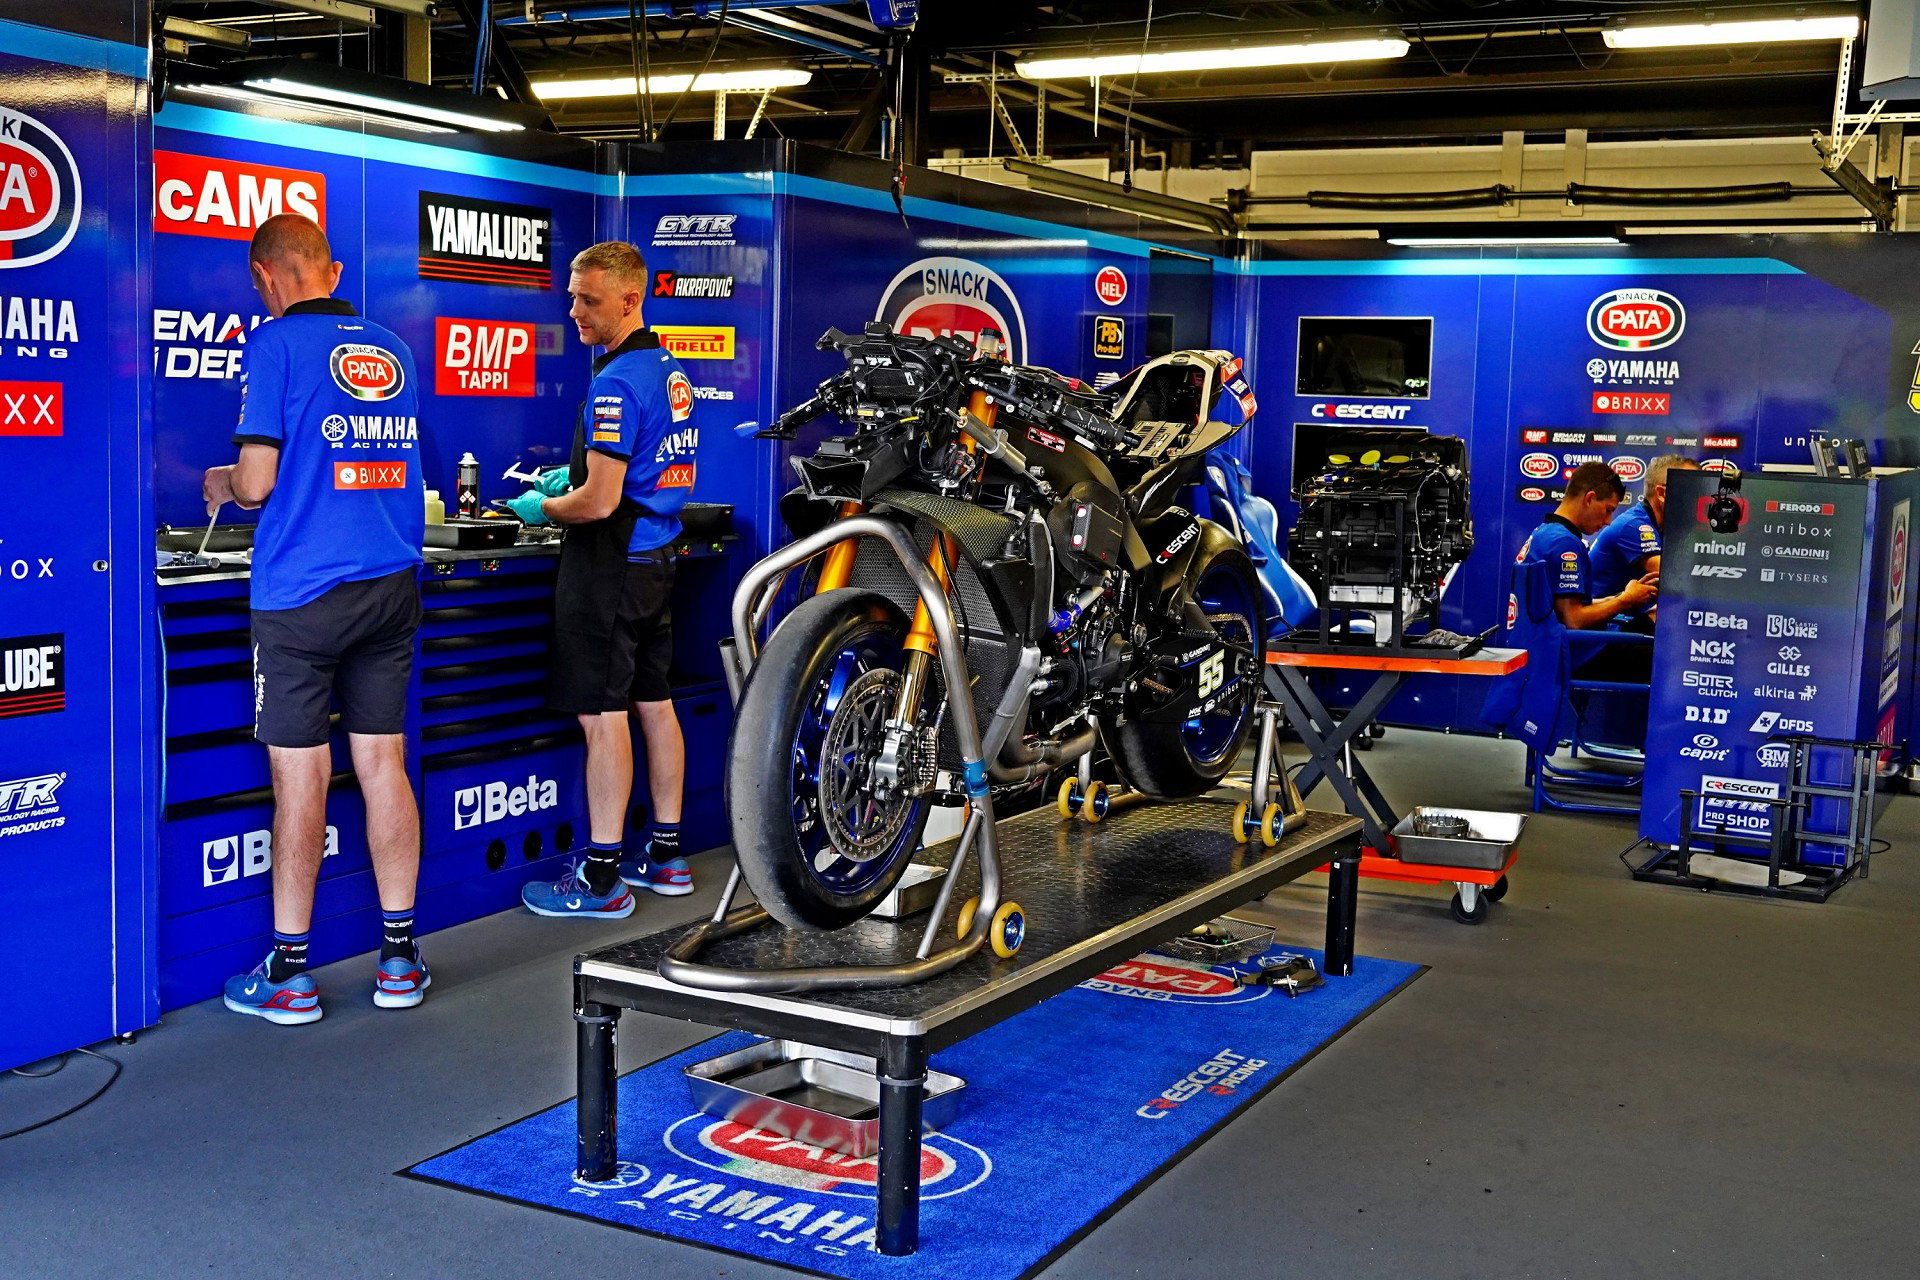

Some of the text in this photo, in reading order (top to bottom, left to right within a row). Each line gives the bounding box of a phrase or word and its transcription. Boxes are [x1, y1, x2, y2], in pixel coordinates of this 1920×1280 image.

[152, 162, 319, 227] cAMS
[655, 215, 736, 233] GYTR
[428, 204, 544, 263] YAMALUBE
[925, 268, 985, 301] SNACK
[1101, 281, 1122, 298] HEL
[1618, 293, 1655, 301] SNACK
[1608, 309, 1662, 329] PATA
[445, 324, 529, 370] BMP
[347, 361, 388, 381] PATA
[1608, 360, 1680, 378] YAMAHA
[458, 370, 508, 390] TAPPI
[1311, 403, 1411, 419] CRESCENT
[1611, 396, 1666, 410] BRIXX
[348, 415, 418, 440] YAMAHA
[1704, 438, 1737, 446] McAMS
[1528, 461, 1549, 470] PATA
[1615, 464, 1637, 474] PATA
[1780, 502, 1820, 513] FERODO
[1764, 523, 1832, 538] unibox
[1156, 523, 1199, 565] CRESCENT
[1694, 540, 1746, 556] minoli
[1775, 547, 1825, 558] GANDINI
[1691, 565, 1747, 579] WRS
[1779, 572, 1828, 584] TYSERS
[1704, 612, 1748, 630] Beta
[1690, 639, 1736, 659] NGK
[1198, 648, 1225, 699] 55
[1767, 662, 1810, 677] GILLES
[1698, 688, 1738, 699] CLUTCH
[1754, 685, 1795, 700] alkiria
[1685, 706, 1728, 724] D.I.D
[1779, 719, 1814, 732] DFDS
[1680, 747, 1729, 761] capit
[1706, 780, 1774, 796] CRESCENT
[485, 775, 558, 824] Beta
[0, 817, 66, 837] PRODUCTS
[1705, 811, 1770, 829] PRO SHOP
[243, 825, 339, 878] Ba
[1106, 967, 1220, 992] PAT
[1136, 1048, 1245, 1119] CRESCENT
[1206, 1058, 1268, 1096] RACING
[568, 1186, 849, 1256] RACING
[641, 1173, 876, 1251] YAMAHA
